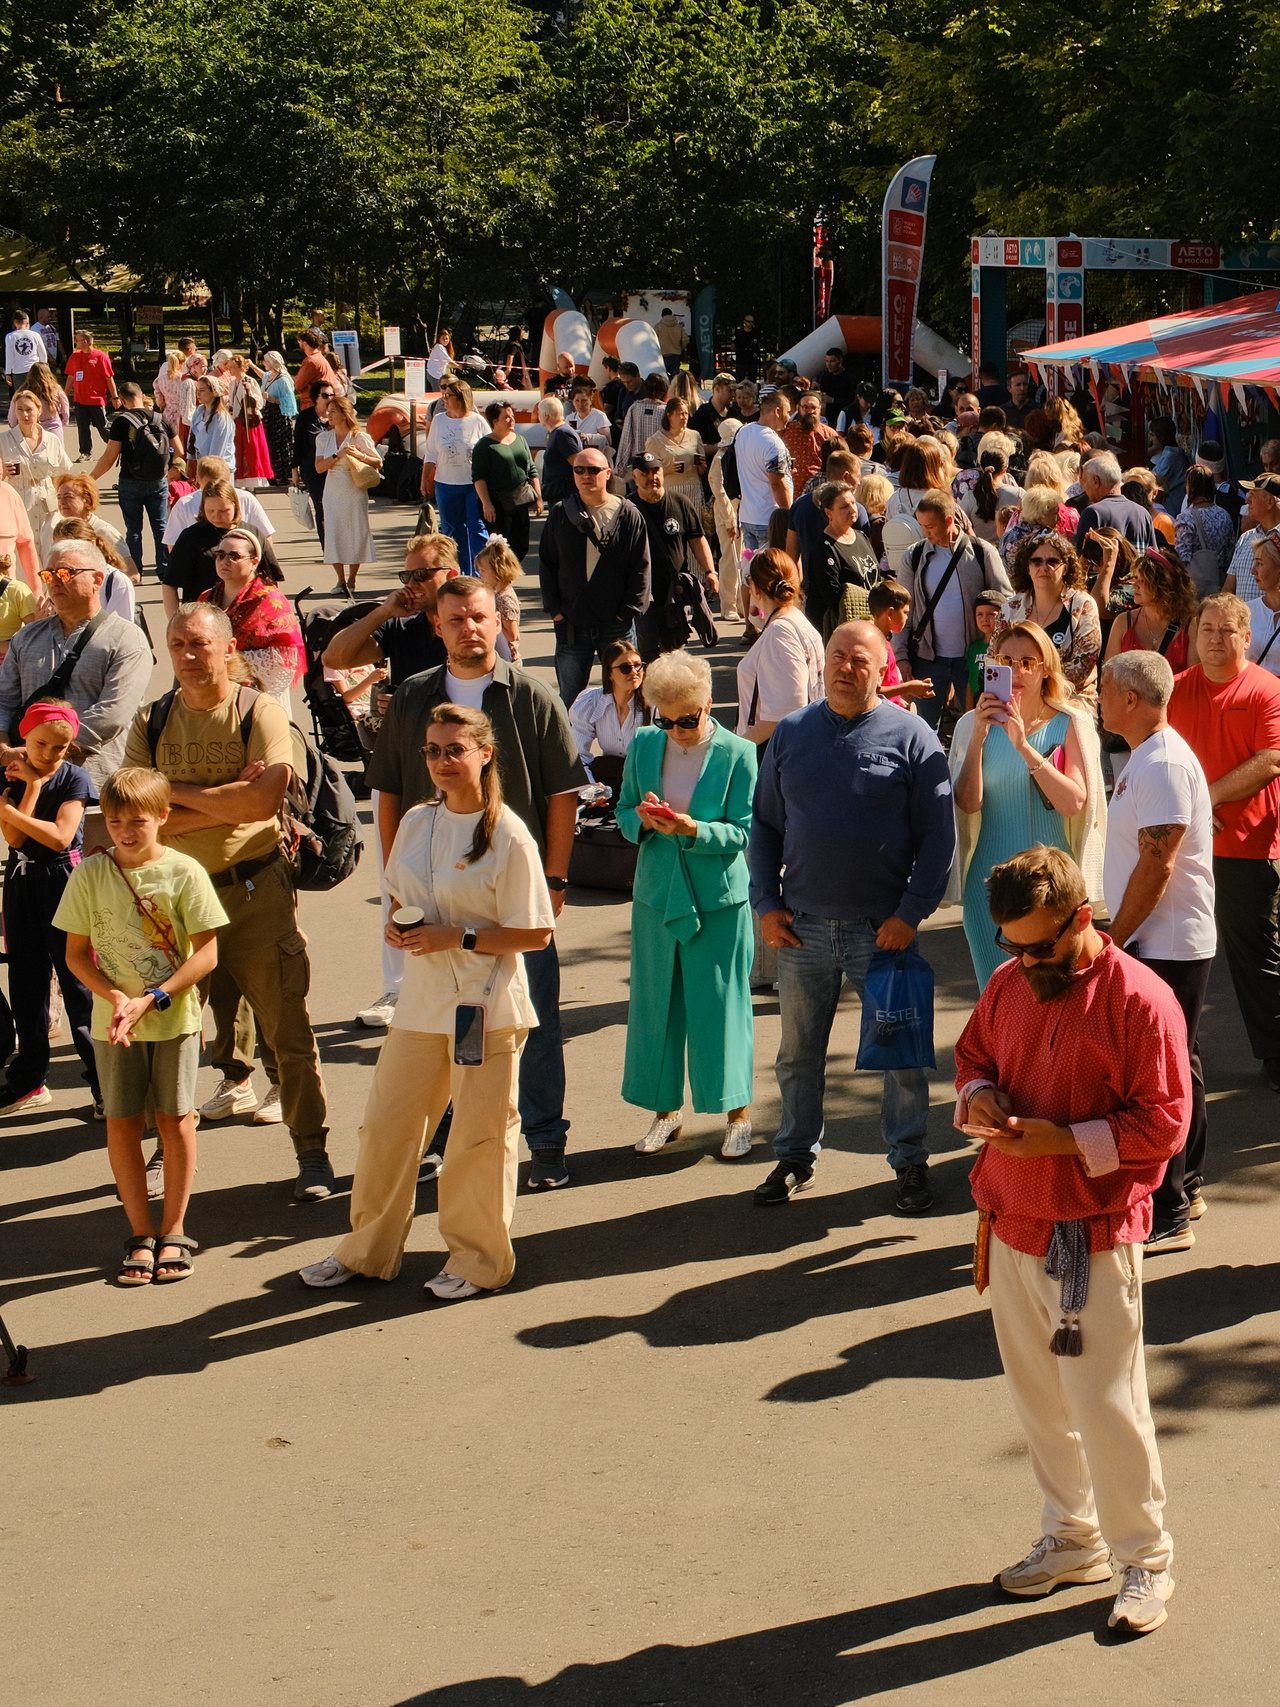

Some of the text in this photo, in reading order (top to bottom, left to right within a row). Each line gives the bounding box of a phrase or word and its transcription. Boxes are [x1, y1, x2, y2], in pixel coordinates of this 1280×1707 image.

[1006, 244, 1018, 254] ЛЕТО
[1178, 246, 1214, 257] ЛЕТО
[699, 314, 711, 354] ЛЕТО
[893, 294, 904, 368] ЛЕТО
[162, 741, 244, 765] BOSS
[875, 1007, 921, 1023] ESTEL
